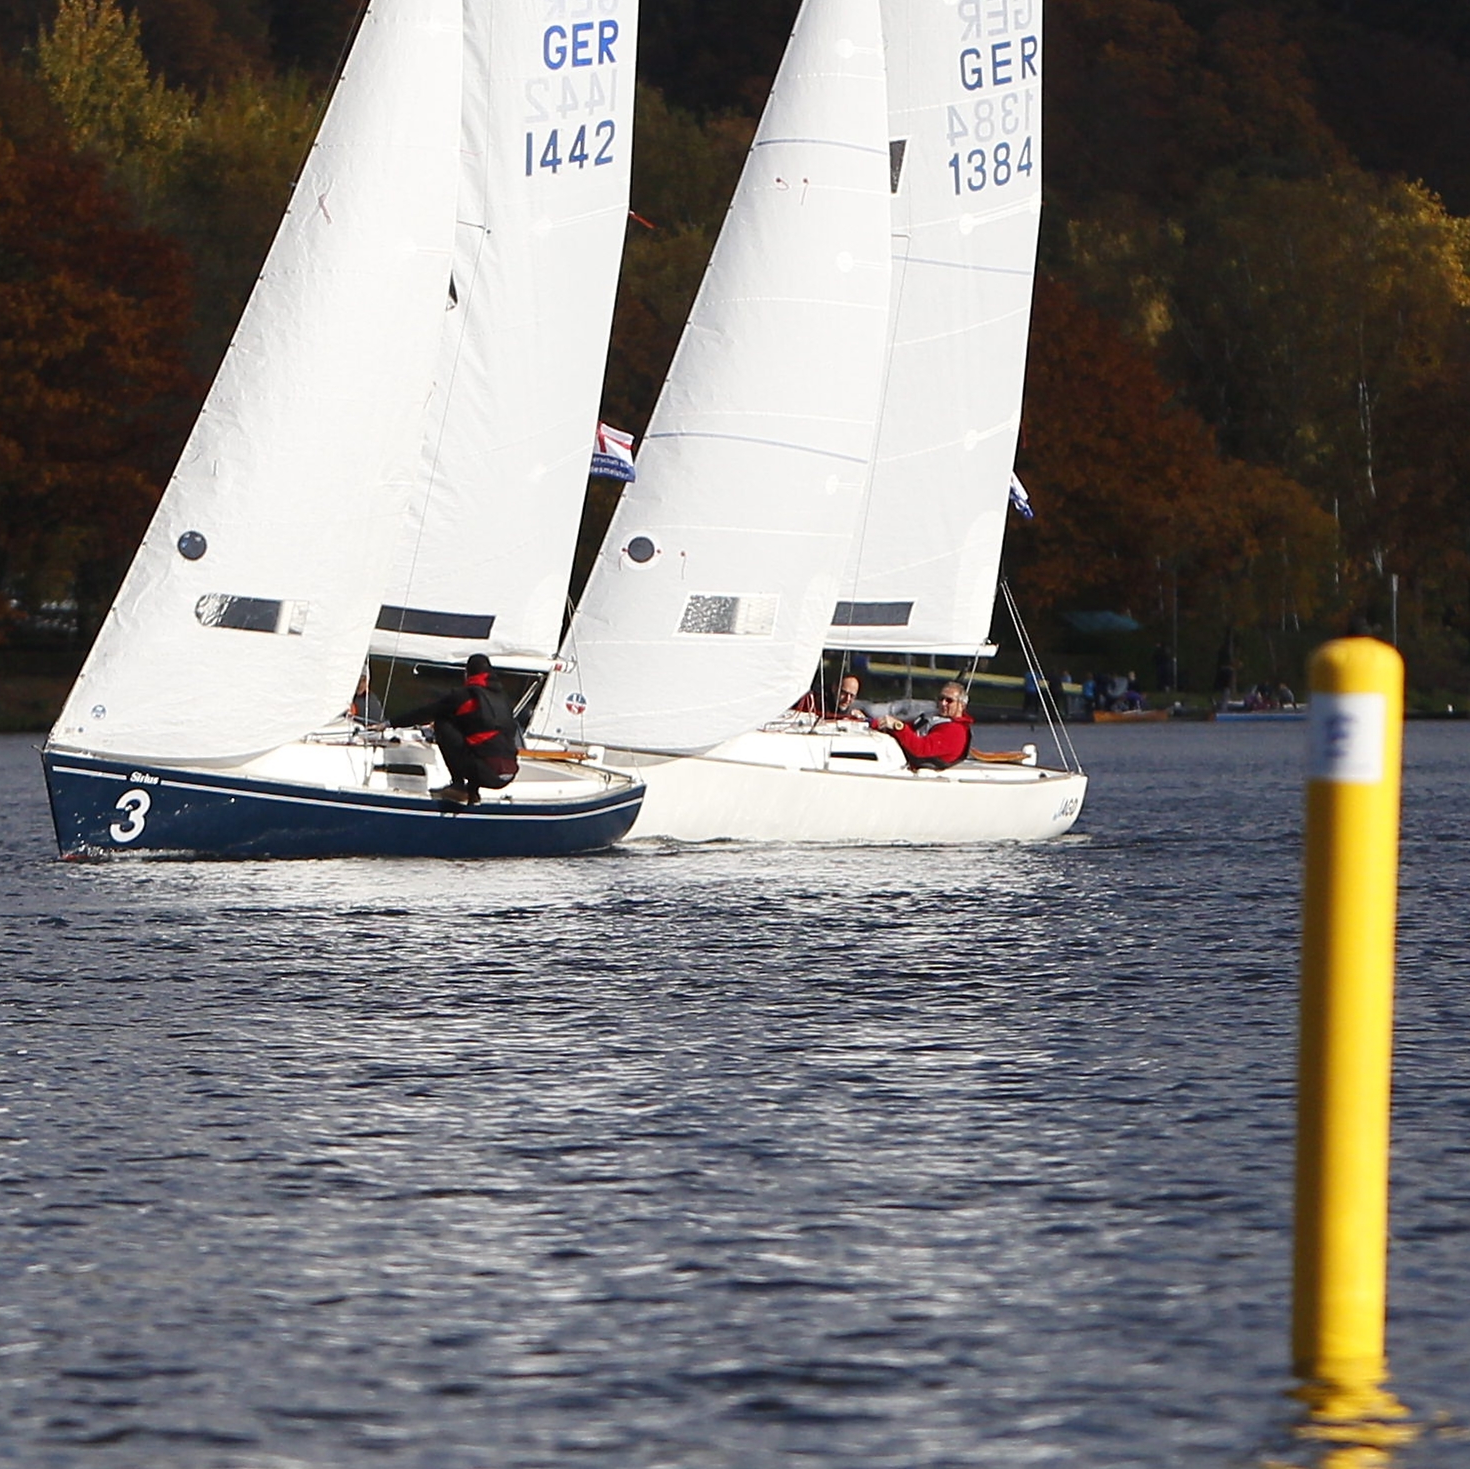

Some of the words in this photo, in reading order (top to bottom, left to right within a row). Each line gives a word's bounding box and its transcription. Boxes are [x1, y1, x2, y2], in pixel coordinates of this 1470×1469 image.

[543, 19, 619, 70] GER
[960, 35, 1038, 91] GER
[525, 119, 616, 177] 1442
[948, 135, 1033, 196] 1384
[130, 771, 160, 785] Sirius
[110, 789, 150, 843] 3
